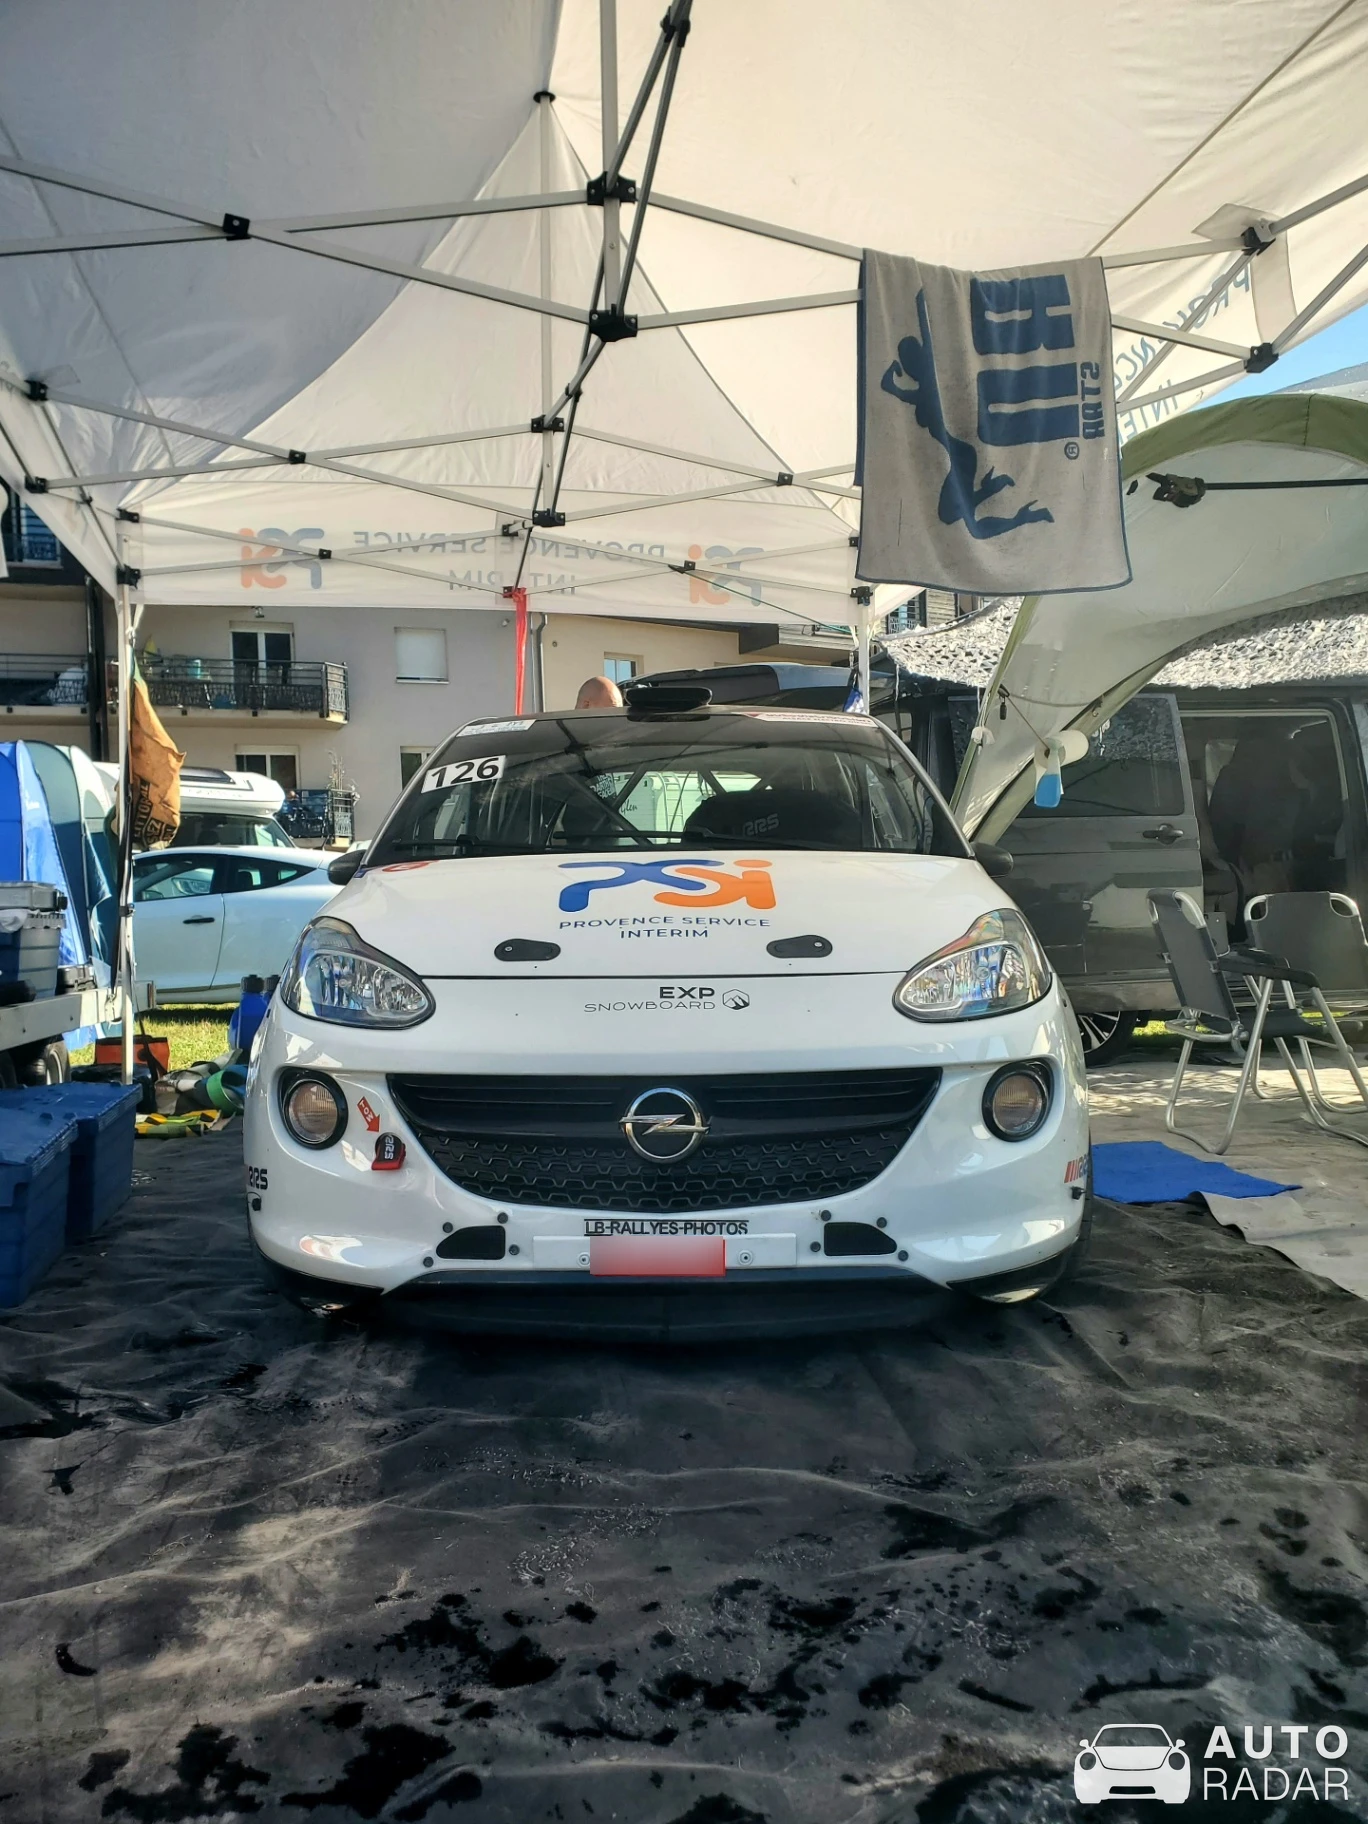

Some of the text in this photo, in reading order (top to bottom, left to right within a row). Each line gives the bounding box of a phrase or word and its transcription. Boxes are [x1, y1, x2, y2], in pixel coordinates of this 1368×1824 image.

[431, 757, 499, 788] 126
[559, 916, 771, 930] PROVENCE SERVICE
[621, 929, 709, 939] INTERIM
[659, 986, 715, 999] EXP
[584, 1001, 716, 1013] SNOWBOARD
[359, 1099, 374, 1122] TOW
[585, 1220, 749, 1236] LB-RALLYES-PHOTOS
